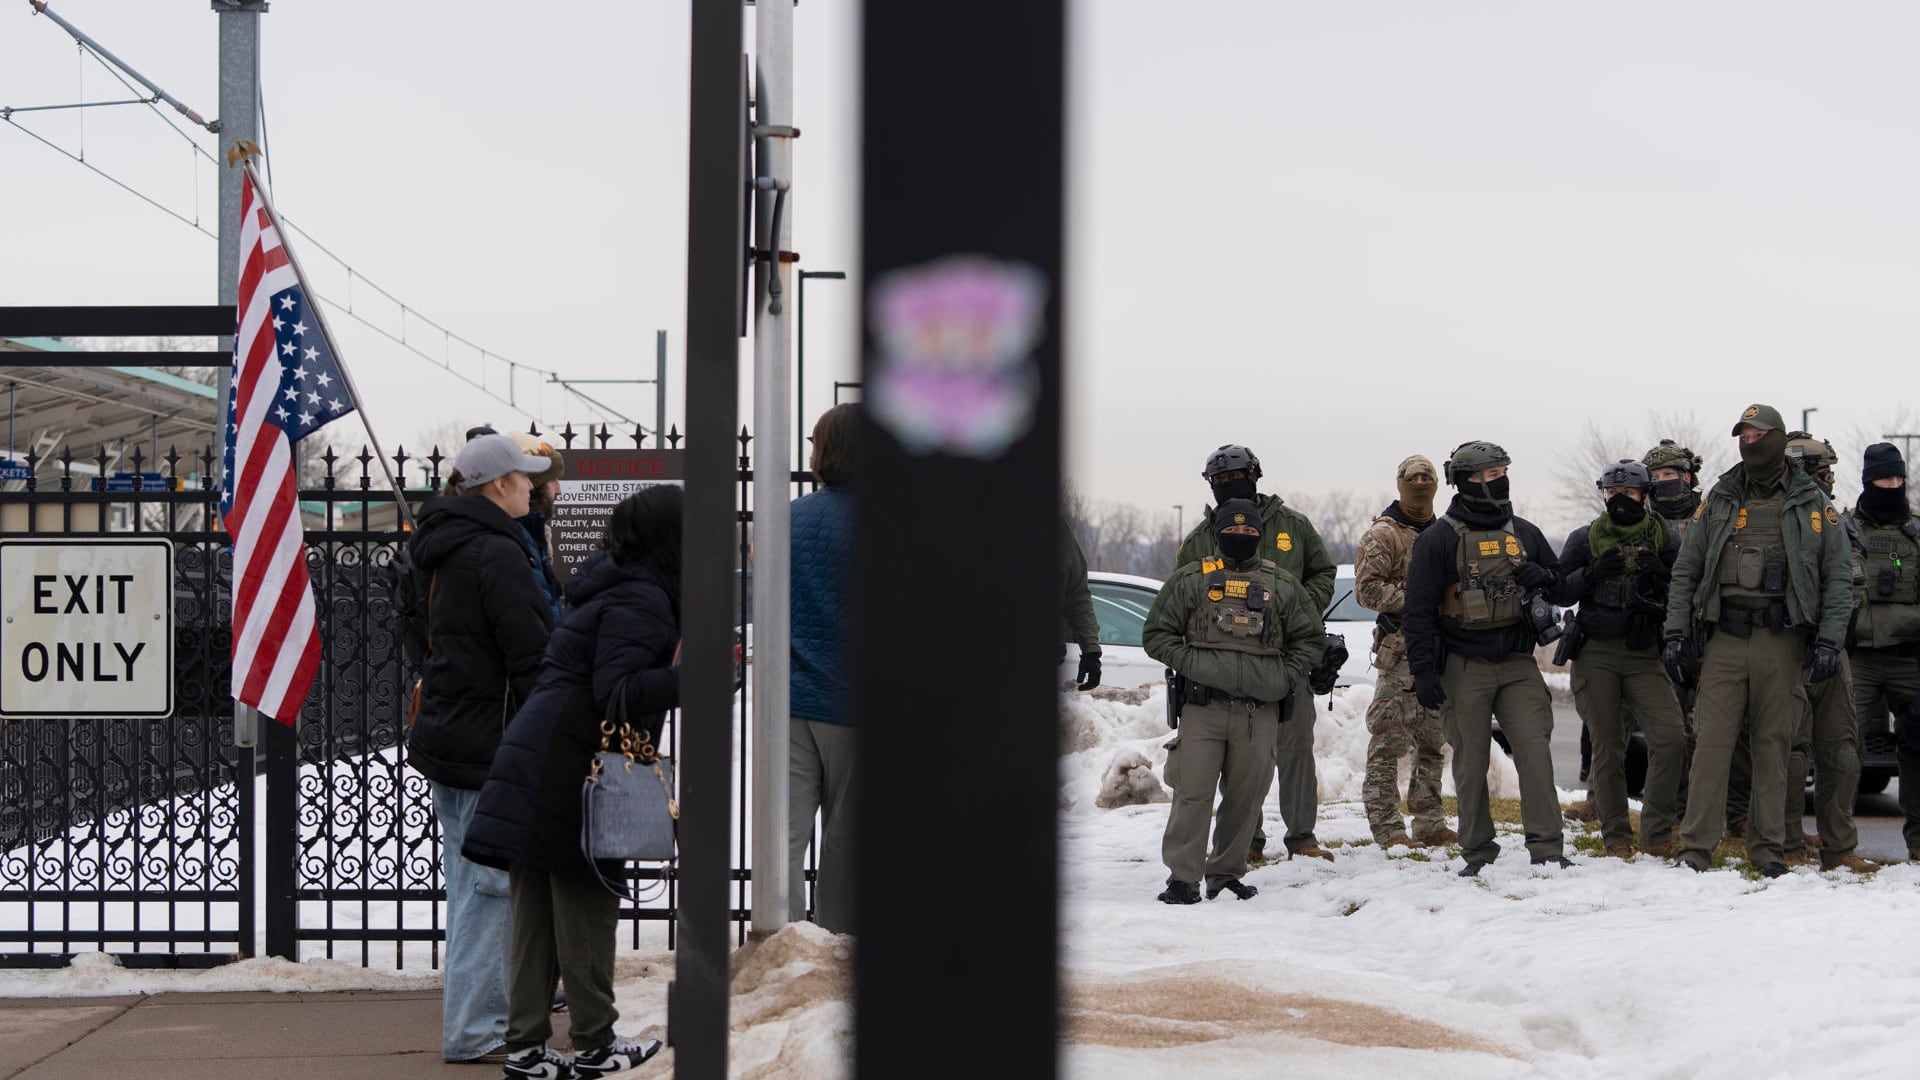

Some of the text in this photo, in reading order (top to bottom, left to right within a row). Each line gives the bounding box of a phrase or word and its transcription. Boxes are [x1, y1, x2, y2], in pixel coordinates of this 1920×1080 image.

[579, 458, 665, 477] NOTICE
[0, 468, 27, 478] KETS
[581, 483, 619, 492] UNITED
[551, 520, 589, 528] FACILITY,
[33, 575, 134, 614] EXIT
[1225, 586, 1247, 594] PATRO
[21, 642, 146, 682] ONLY
